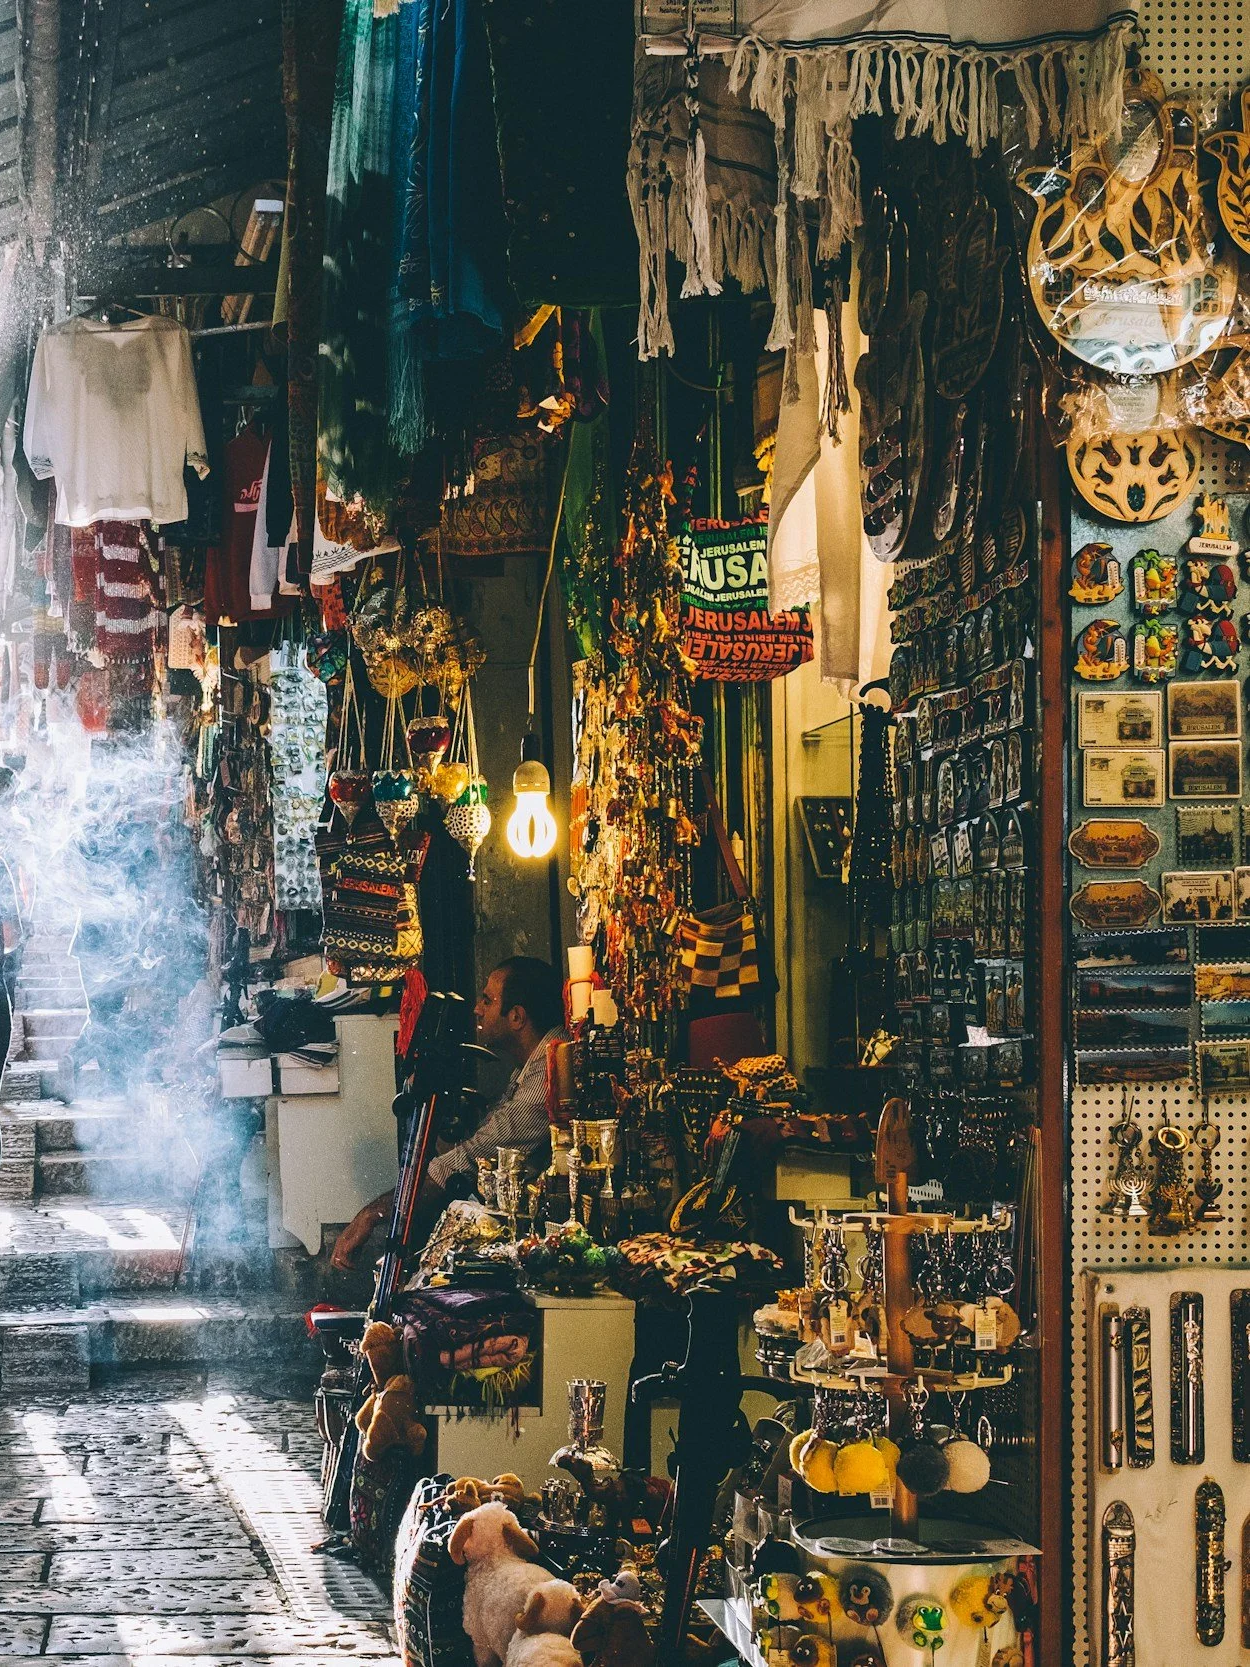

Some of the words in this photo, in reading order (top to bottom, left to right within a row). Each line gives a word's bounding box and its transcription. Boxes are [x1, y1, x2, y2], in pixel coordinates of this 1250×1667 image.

[700, 539, 766, 558] JERUSALEM
[1199, 541, 1232, 551] JERUSALEM
[682, 605, 800, 632] JERUSALEM
